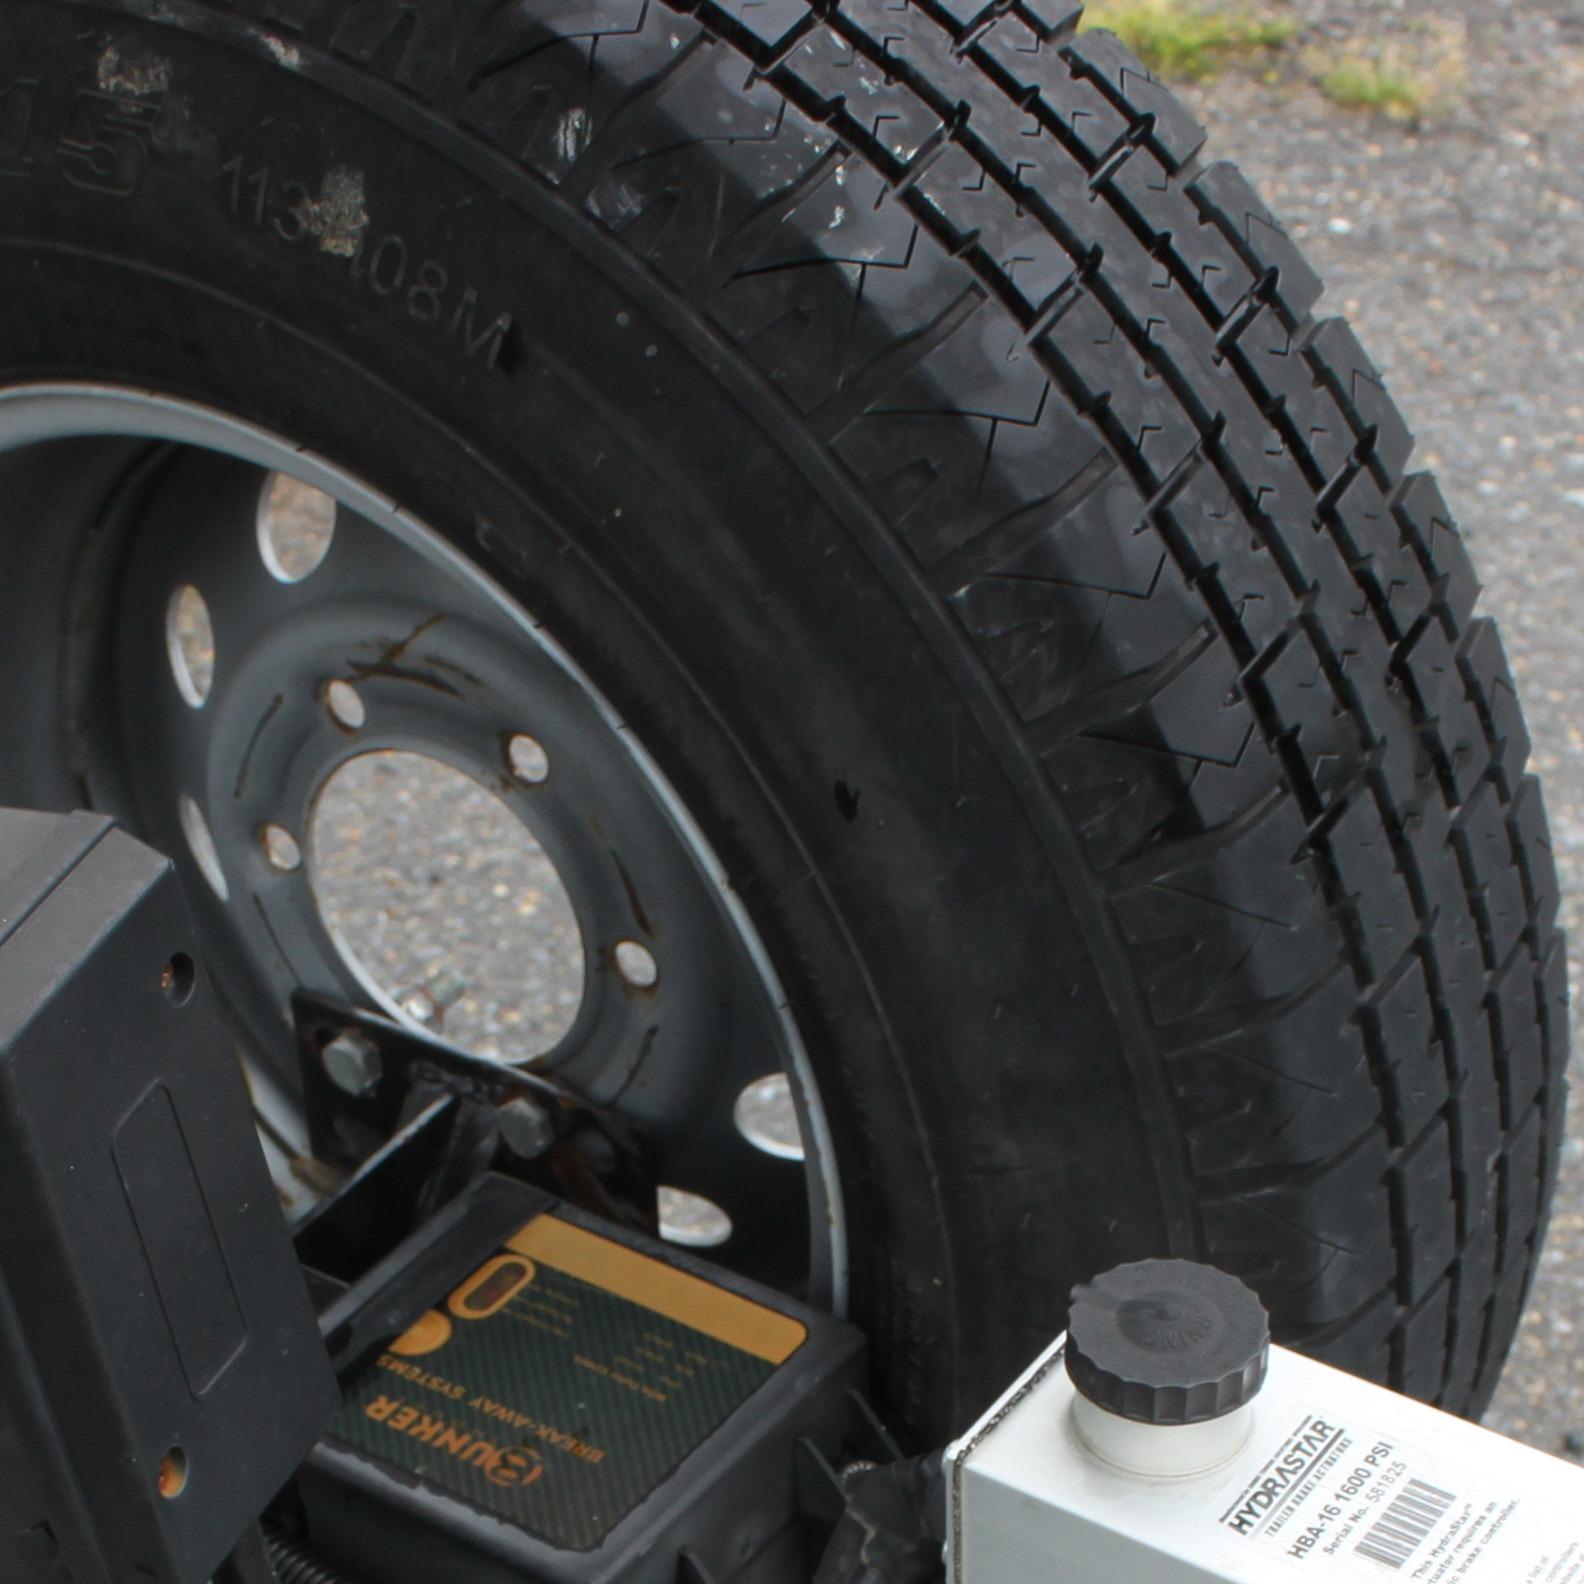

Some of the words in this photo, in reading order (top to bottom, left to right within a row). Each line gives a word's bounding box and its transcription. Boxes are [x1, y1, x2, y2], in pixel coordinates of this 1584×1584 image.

[376, 1354, 466, 1399] SYSTEMS
[470, 1396, 605, 1463] BREAK-AWAY
[1228, 1418, 1336, 1535] HYDRASTAR
[1286, 1503, 1343, 1559] HBA-16
[1331, 1465, 1374, 1504] 1600
[1361, 1440, 1394, 1467] PSI
[1321, 1522, 1355, 1555] Serial
[1347, 1503, 1370, 1523] No.
[1362, 1459, 1408, 1503] 581825
[1450, 1514, 1489, 1554] requires
[1482, 1501, 1498, 1514] an
[1410, 1558, 1433, 1580] This
[1454, 1545, 1484, 1574] brake
